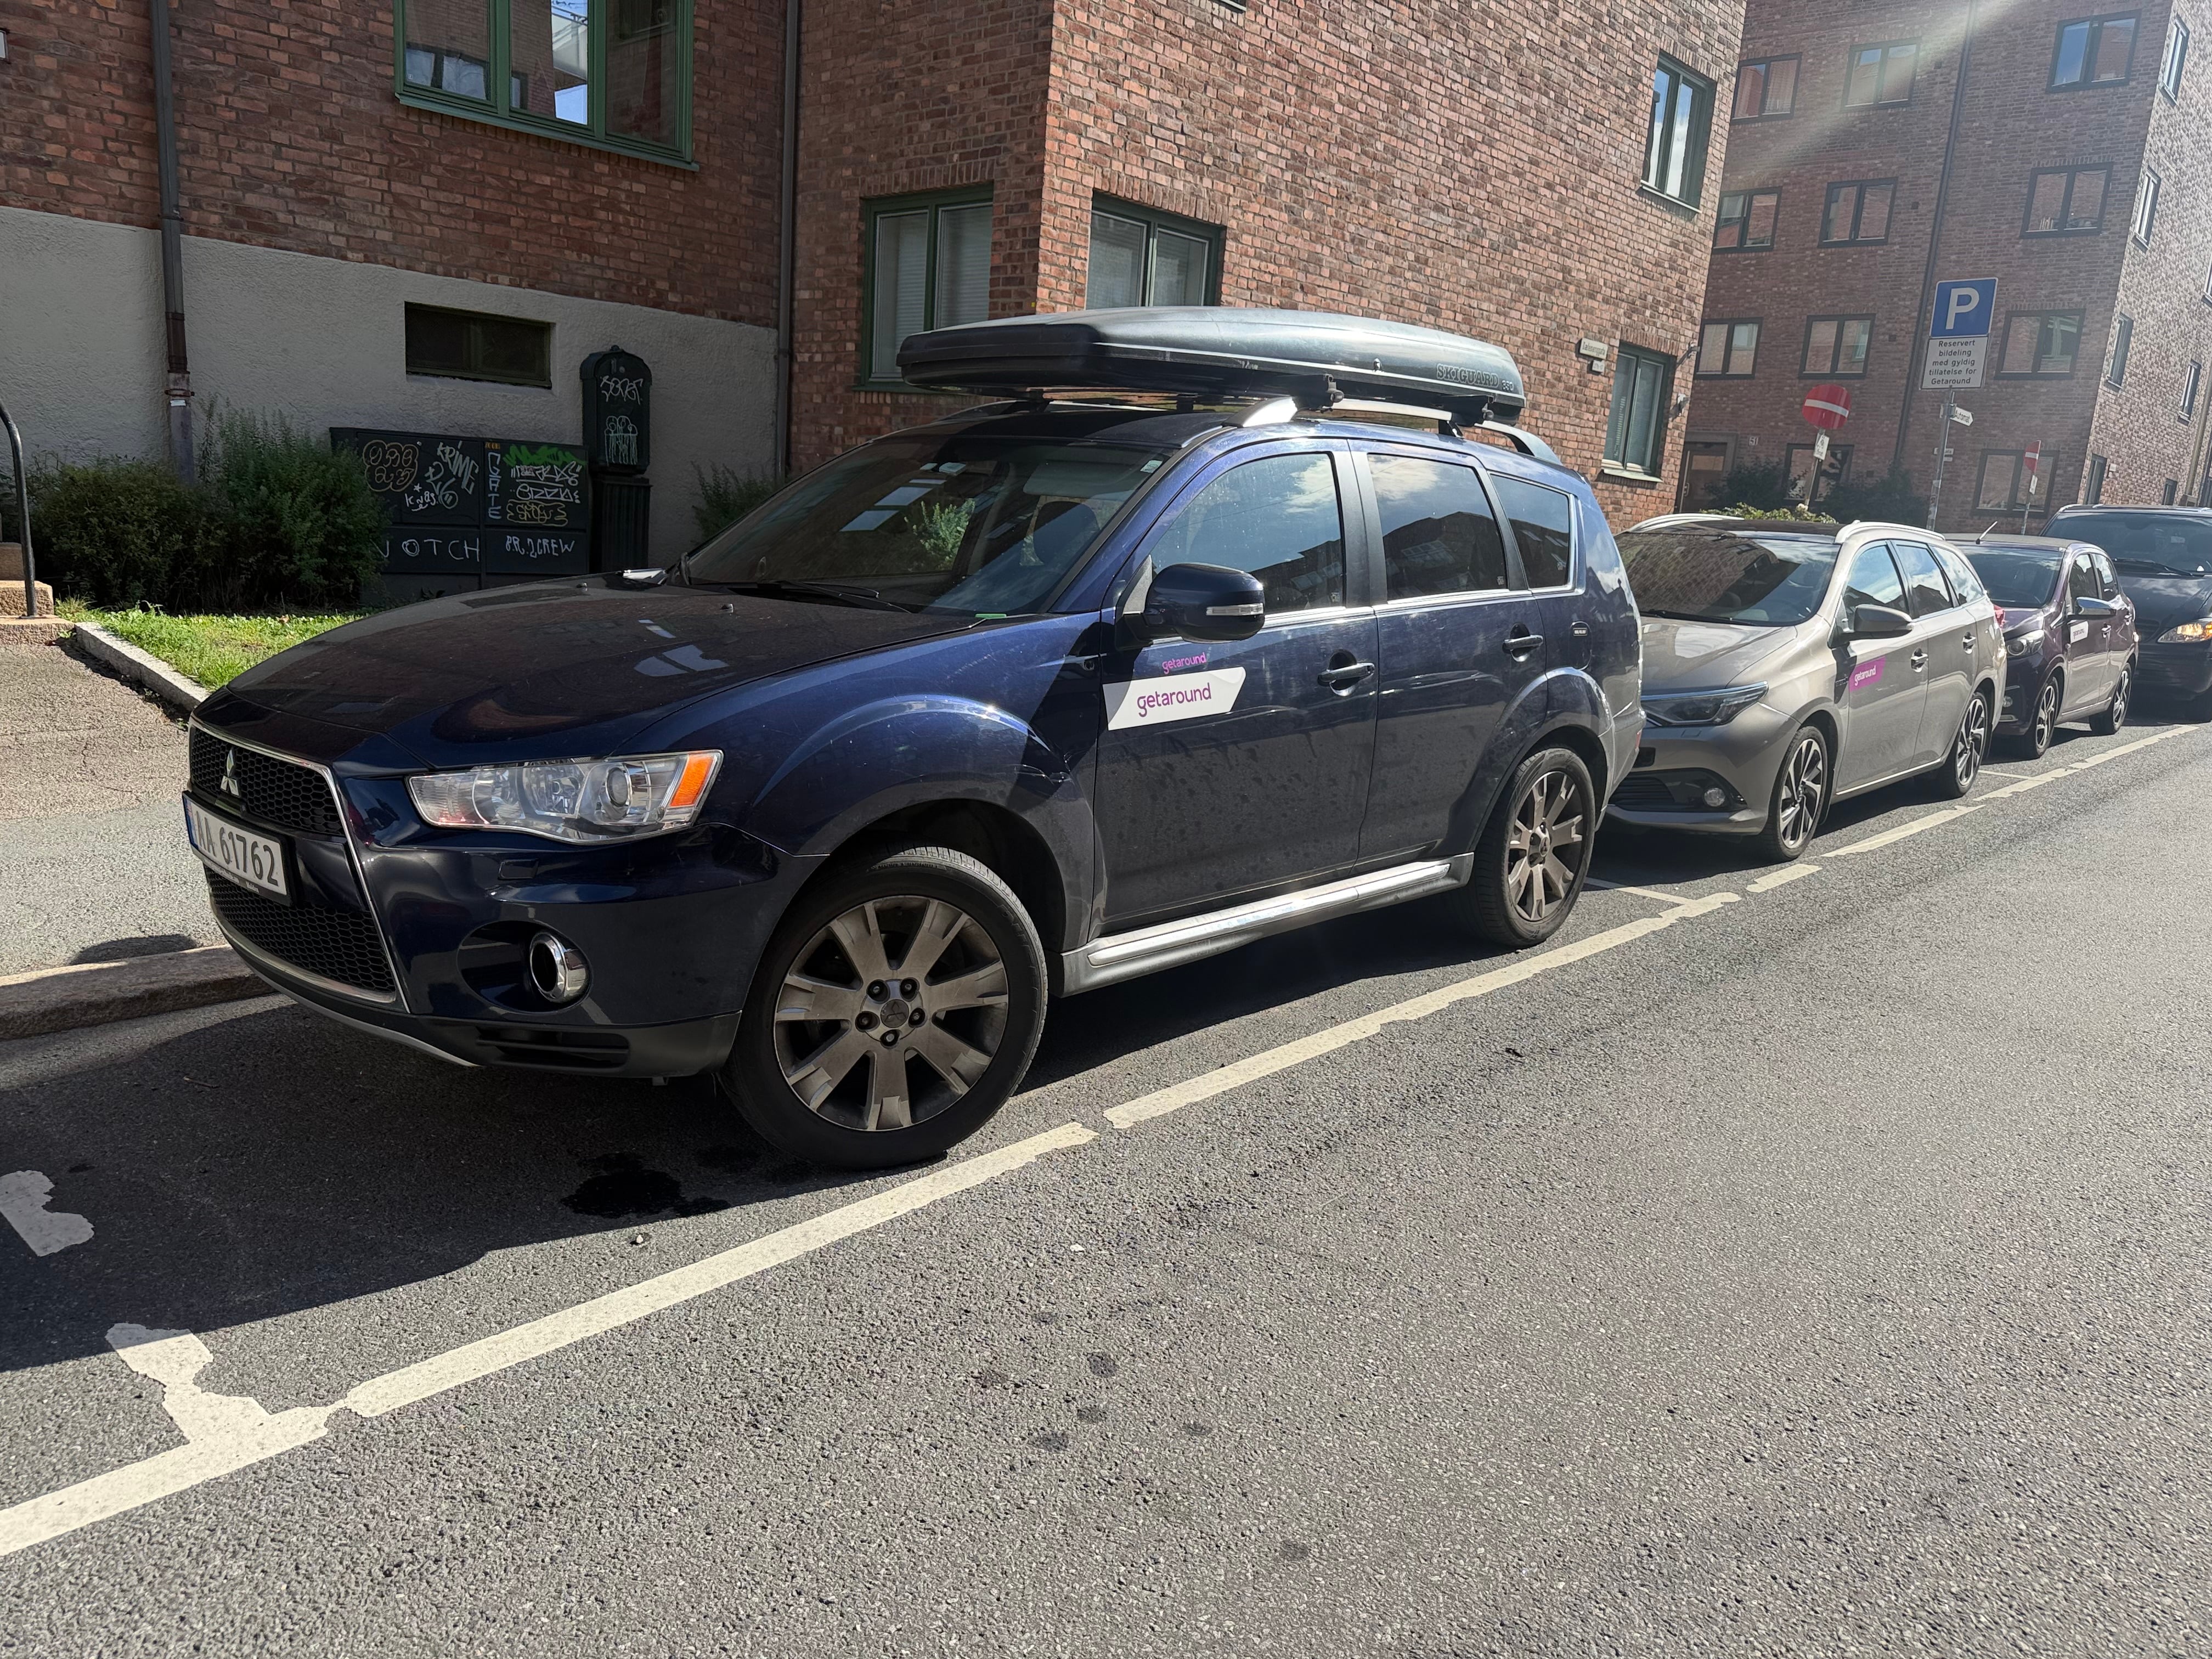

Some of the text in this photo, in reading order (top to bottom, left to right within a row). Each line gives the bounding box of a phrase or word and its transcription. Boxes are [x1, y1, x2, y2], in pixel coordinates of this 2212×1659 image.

[1945, 287, 1979, 329] P
[1437, 363, 1499, 388] SKIGUARD
[1162, 652, 1206, 675] getaround
[1854, 665, 1876, 687] getaround
[1137, 682, 1212, 718] getaround
[219, 827, 279, 887] 61762
